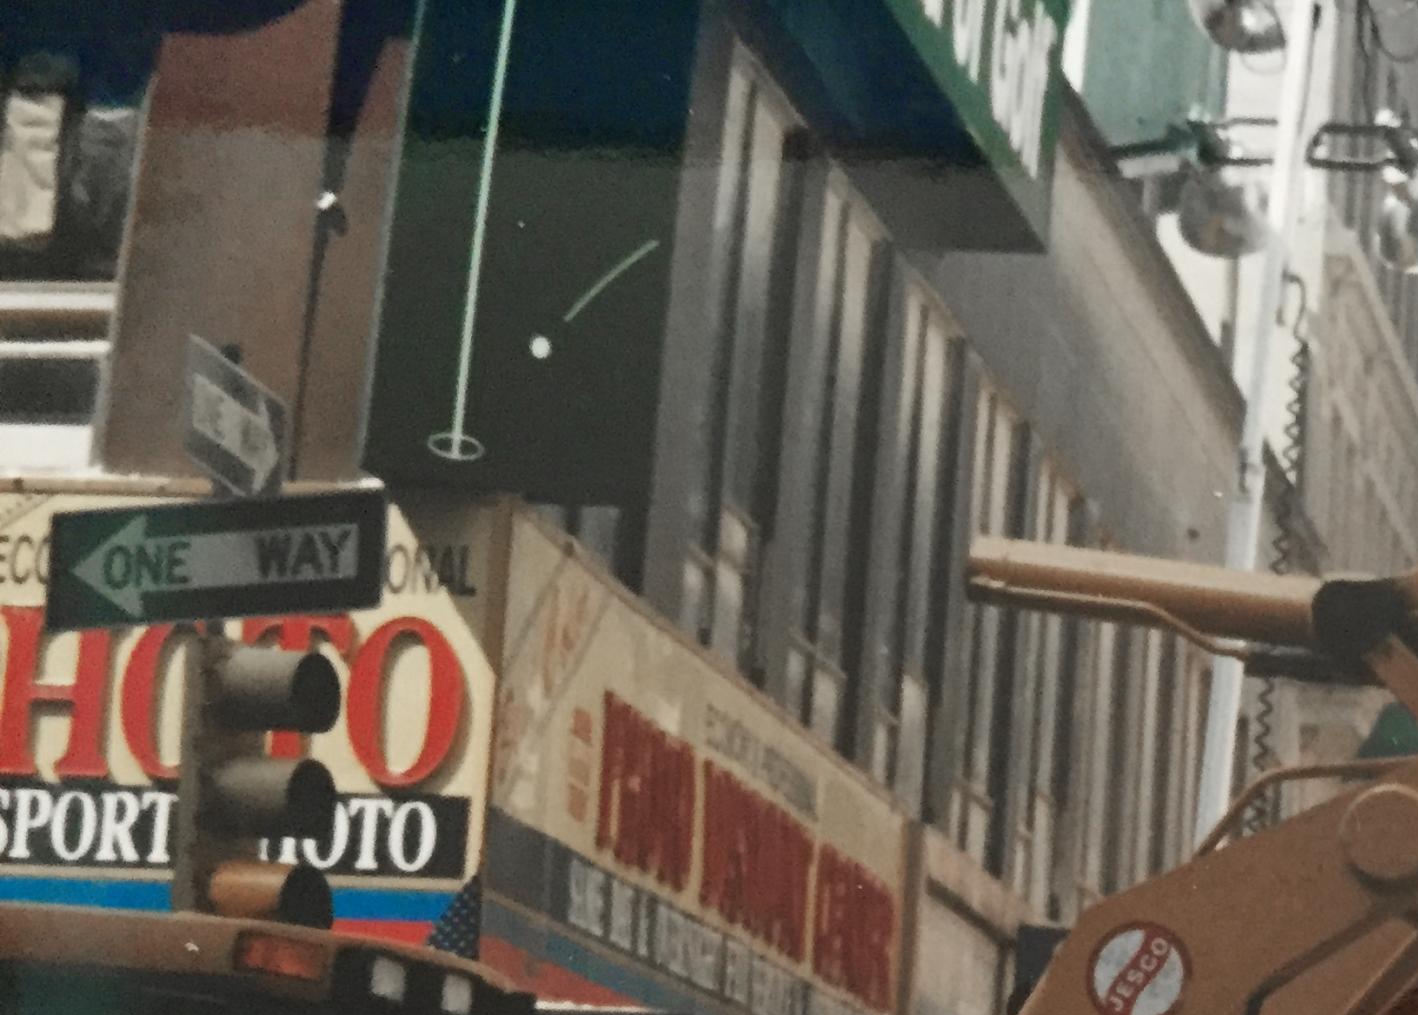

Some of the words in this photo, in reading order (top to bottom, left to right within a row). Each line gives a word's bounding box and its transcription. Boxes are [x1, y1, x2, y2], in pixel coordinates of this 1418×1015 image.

[104, 540, 191, 590] ONE
[255, 529, 352, 582] WAY
[0, 789, 180, 862] PORT
[1110, 937, 1168, 1012] JESCO
